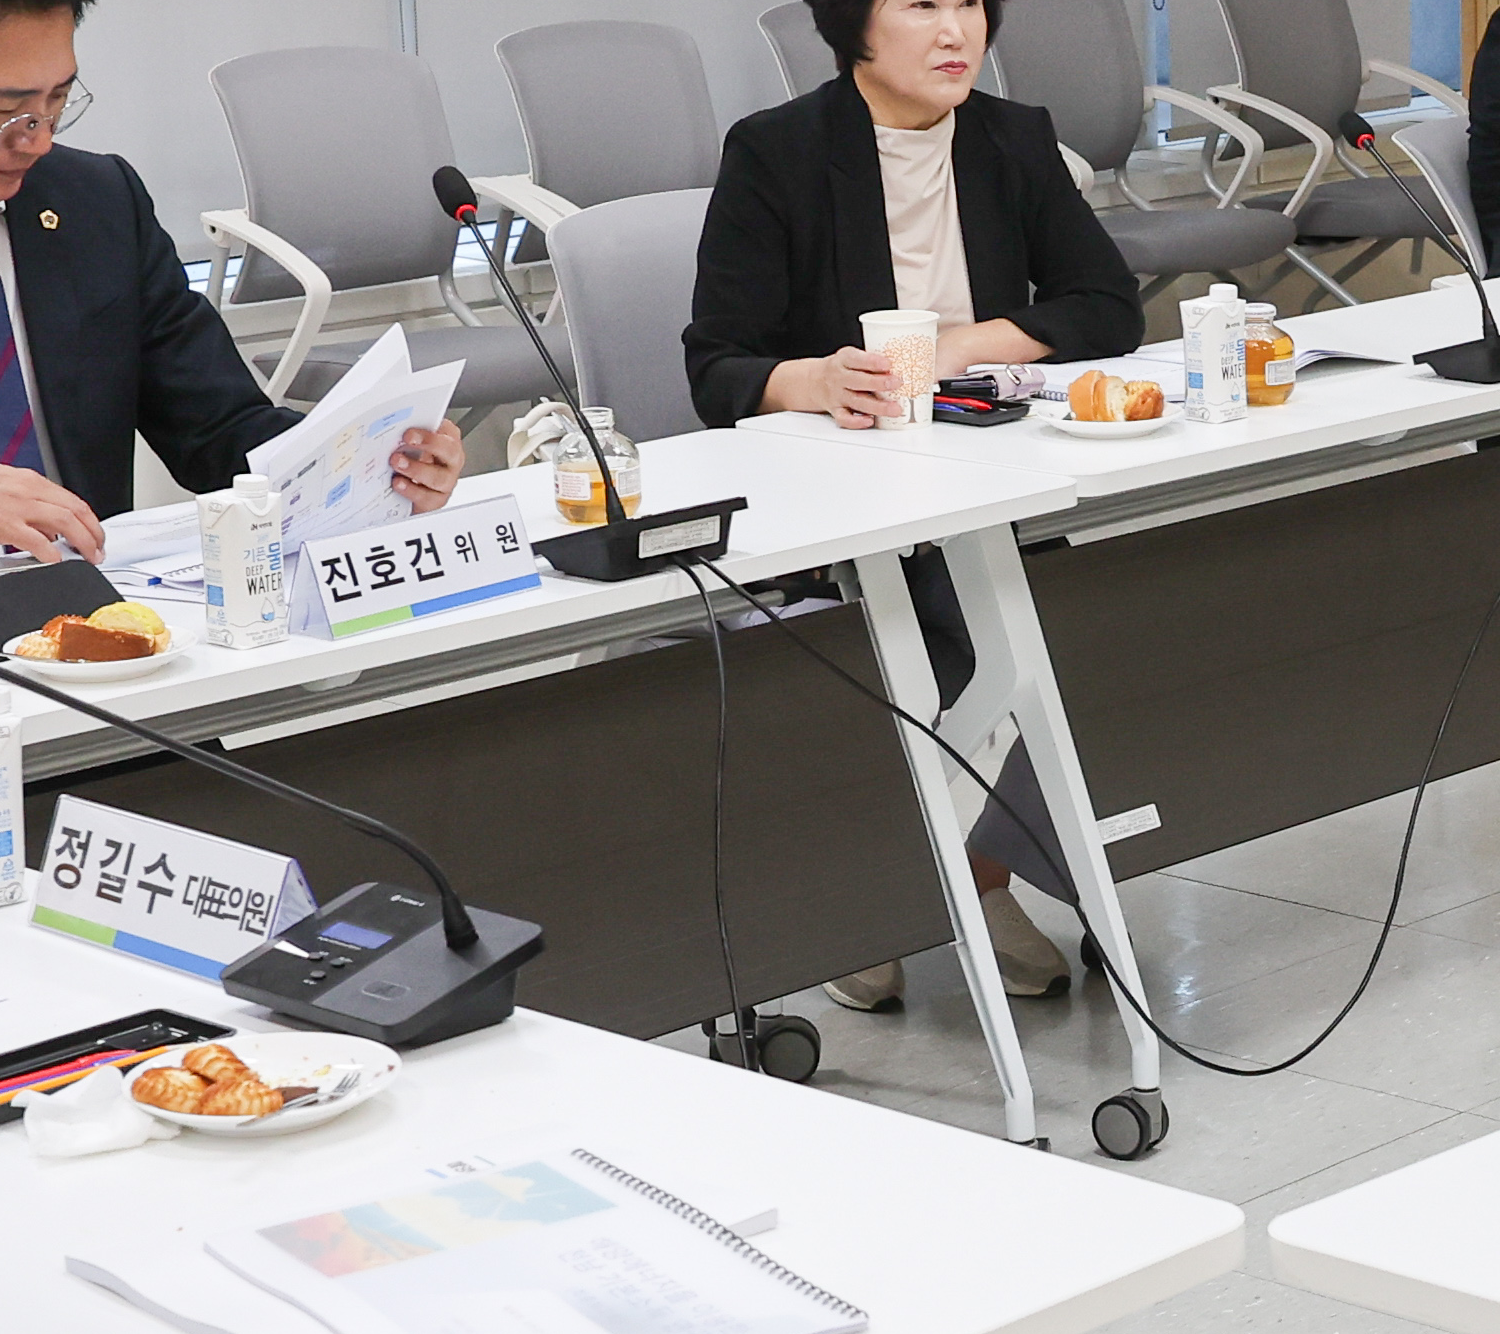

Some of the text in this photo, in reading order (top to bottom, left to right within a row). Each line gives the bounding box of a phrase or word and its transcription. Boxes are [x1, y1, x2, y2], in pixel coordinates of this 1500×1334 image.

[245, 564, 264, 577] DEEP
[246, 571, 284, 596] WATER
[320, 532, 445, 603] 진호건
[53, 825, 177, 914] 정길수
